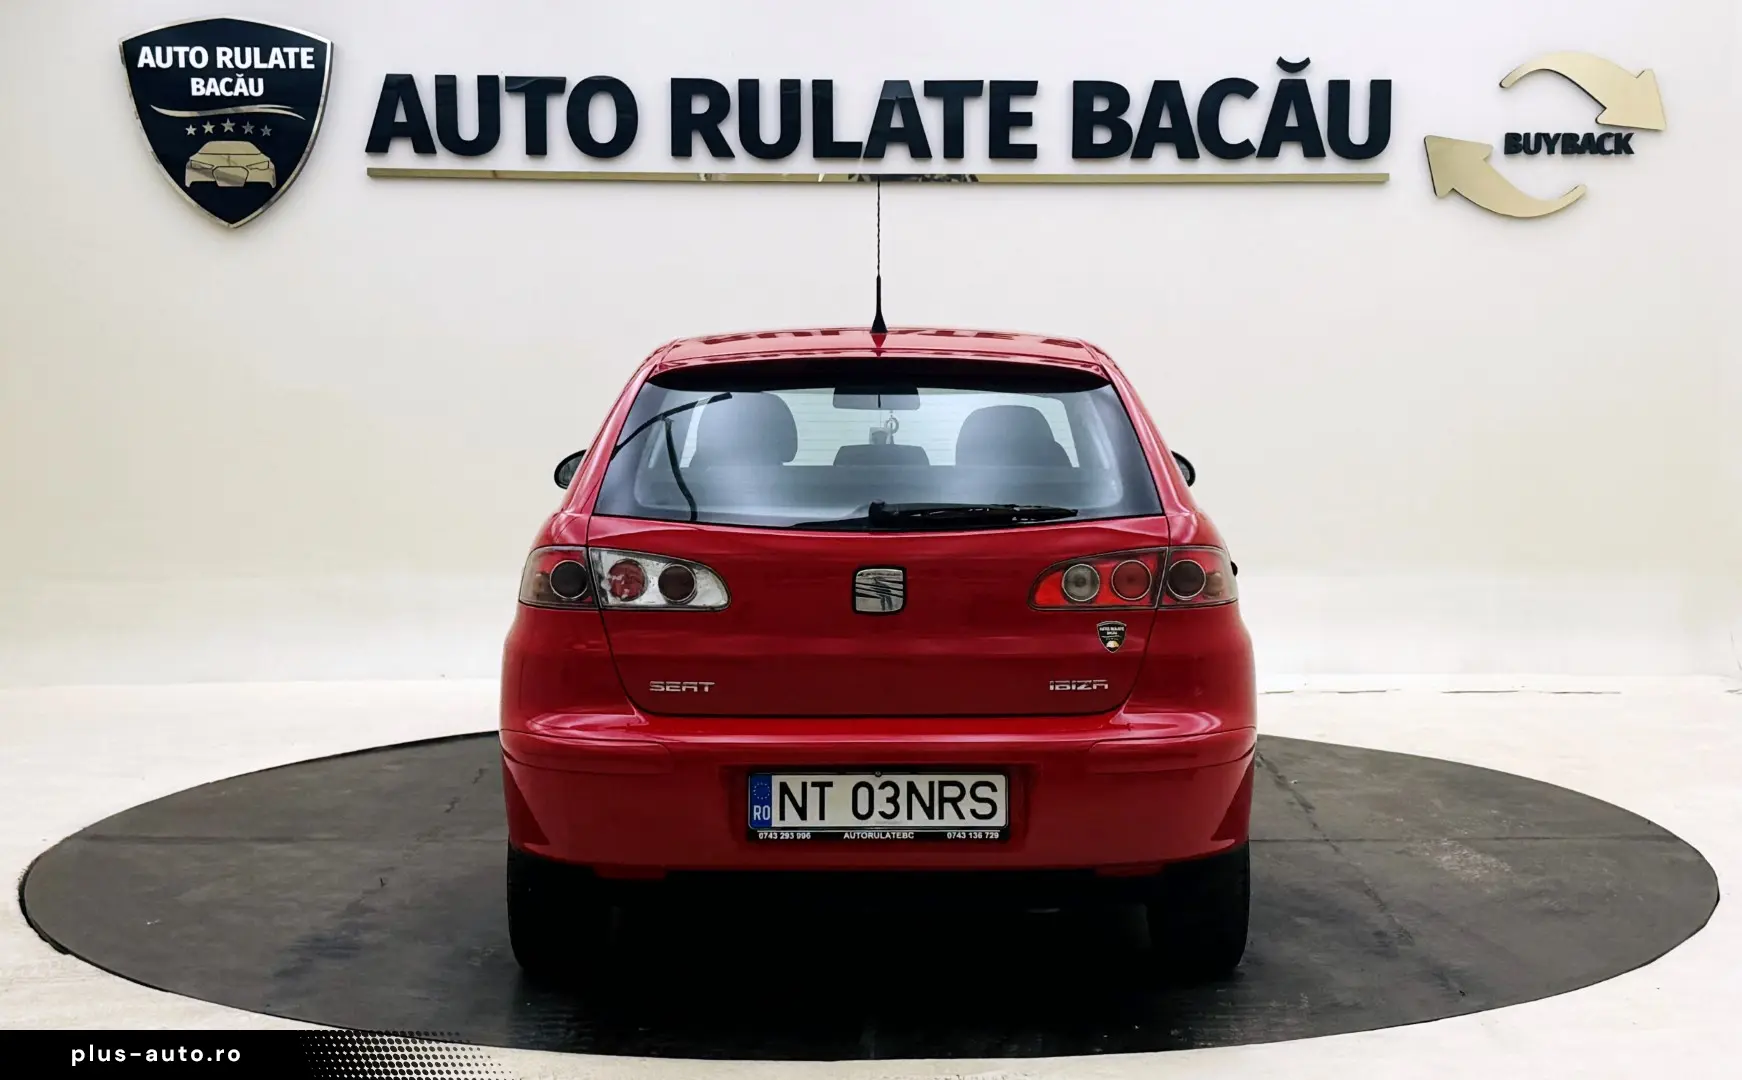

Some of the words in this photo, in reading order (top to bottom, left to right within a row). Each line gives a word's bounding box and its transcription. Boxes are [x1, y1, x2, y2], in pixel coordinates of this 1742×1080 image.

[137, 46, 209, 69] AUTO
[216, 46, 315, 69] RULATE
[190, 73, 264, 97] BACĂU
[365, 73, 639, 158] AUTO
[670, 77, 1039, 159] RULATE
[1071, 56, 1392, 159] BACĂU
[1503, 131, 1635, 156] BUYBACK
[649, 680, 715, 693] SEAT
[1049, 679, 1109, 691] IBIZA
[778, 780, 834, 821] NT
[851, 780, 998, 821] 03NRS
[753, 805, 771, 821] RO
[758, 832, 778, 840] 0743
[843, 831, 915, 840] AUTORULATEBC
[946, 831, 967, 839] 0743
[984, 831, 1000, 839] 729
